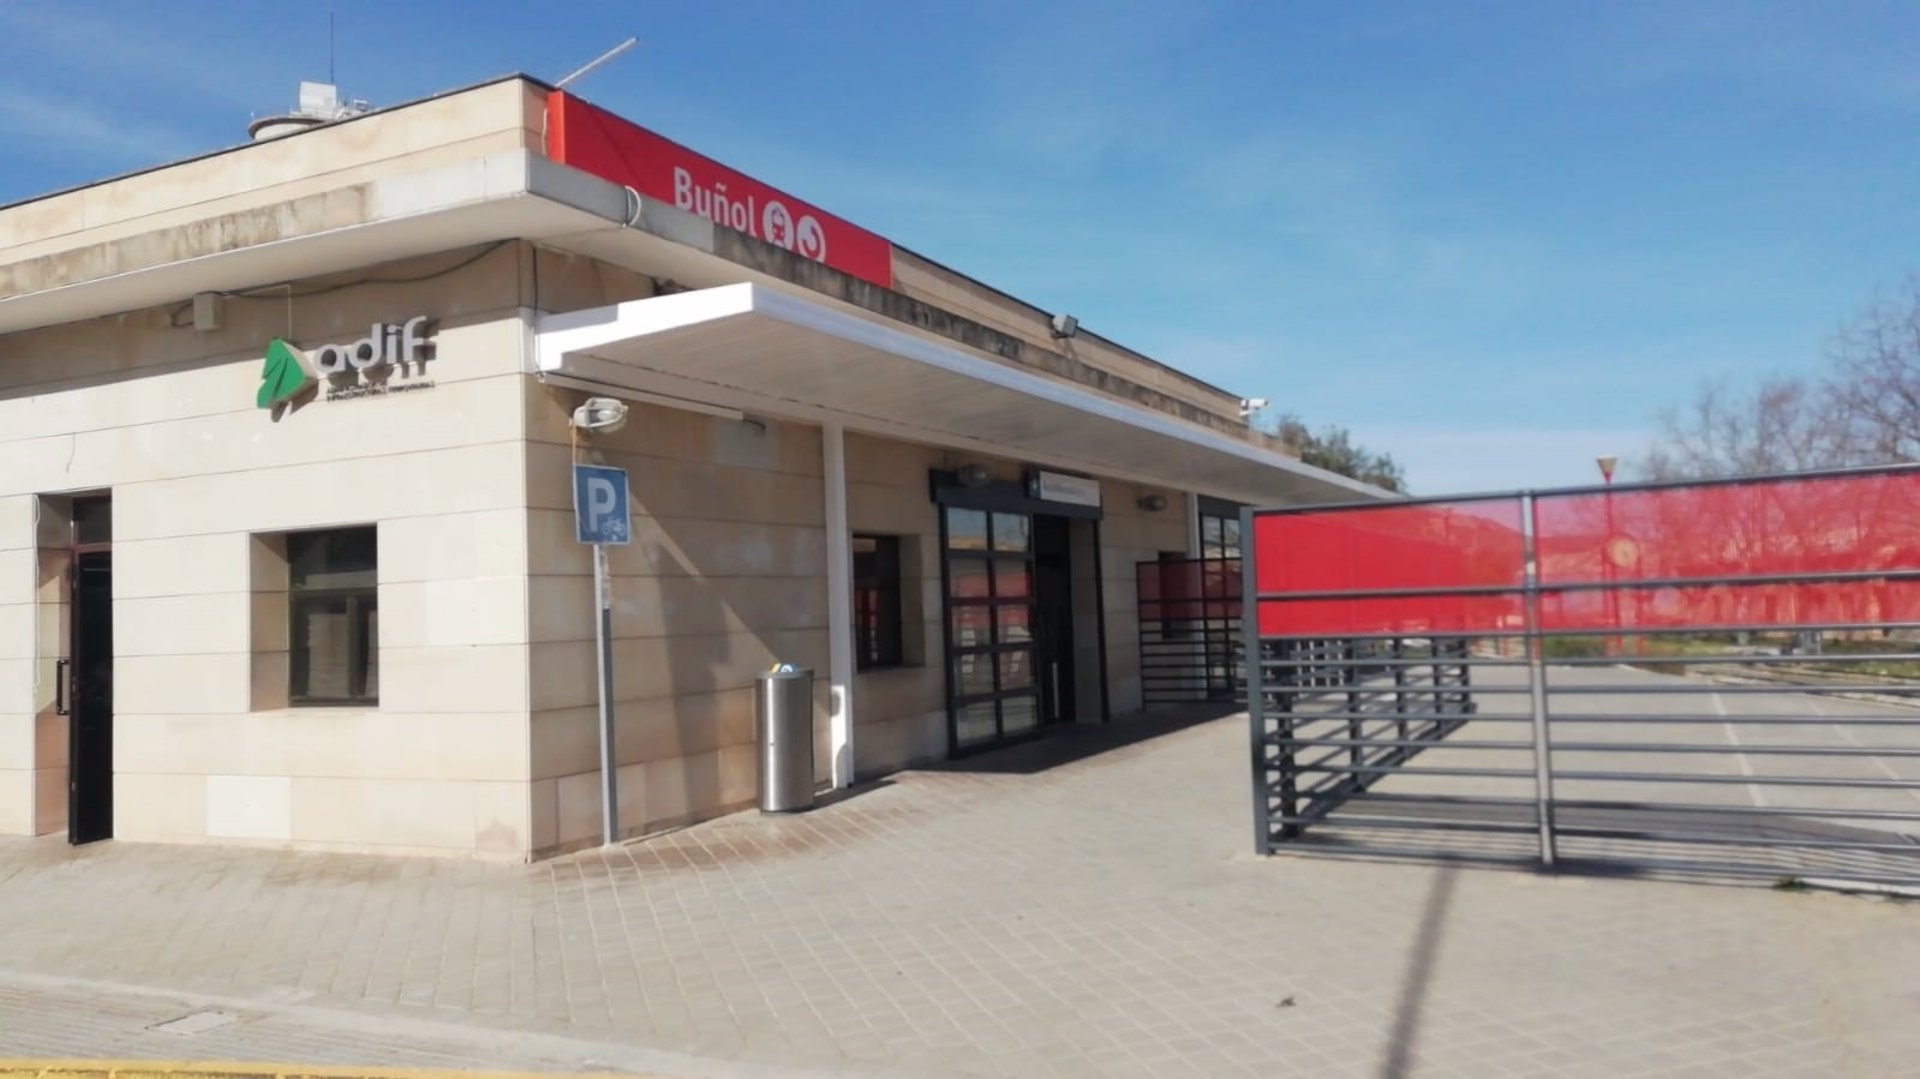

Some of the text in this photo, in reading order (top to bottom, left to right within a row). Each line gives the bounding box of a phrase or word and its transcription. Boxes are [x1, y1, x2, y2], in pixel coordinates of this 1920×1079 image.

[674, 165, 757, 238] Buñol
[313, 315, 427, 375] adif
[587, 477, 616, 533] P
